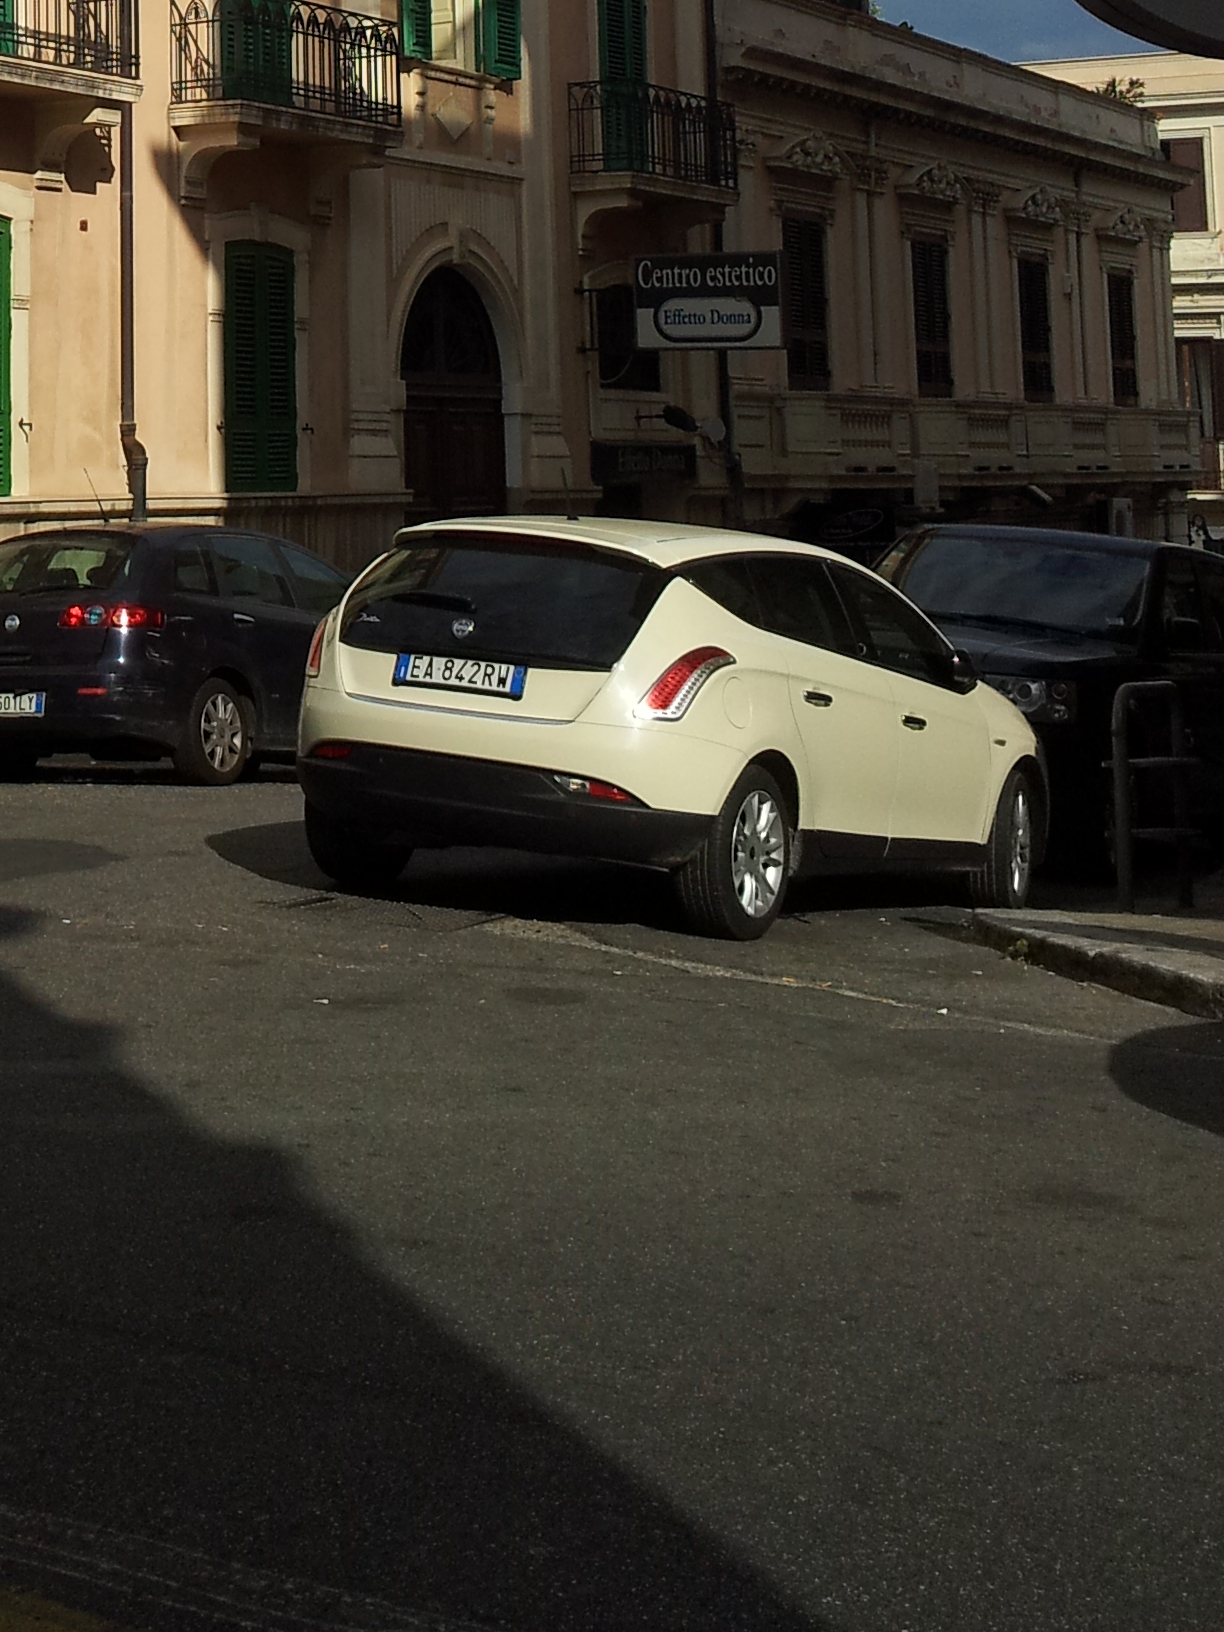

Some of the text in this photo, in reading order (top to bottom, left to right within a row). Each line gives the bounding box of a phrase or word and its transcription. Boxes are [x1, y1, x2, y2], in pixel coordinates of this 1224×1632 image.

[637, 256, 777, 289] Centro estetico
[663, 308, 752, 325] Effetto Donna
[441, 658, 511, 689] 842RW
